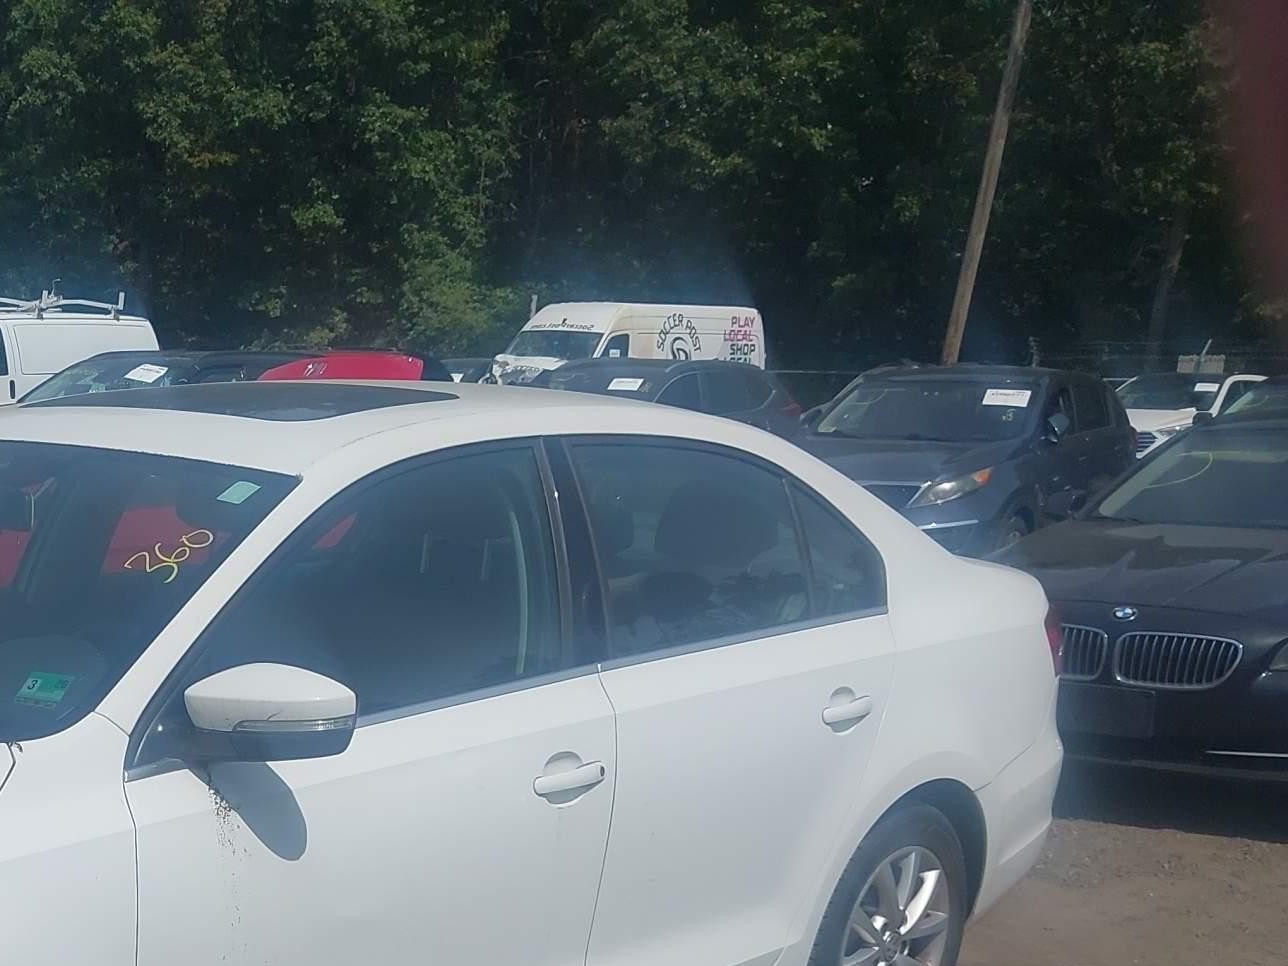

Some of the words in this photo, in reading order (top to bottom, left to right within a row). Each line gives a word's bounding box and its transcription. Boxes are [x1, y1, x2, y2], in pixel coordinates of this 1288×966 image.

[730, 316, 756, 328] PLAY
[657, 313, 684, 352] SOCCER
[685, 319, 702, 352] POST
[723, 329, 754, 342] LOCAL
[729, 343, 756, 356] SHOP
[123, 529, 214, 584] 360
[27, 679, 38, 690] 3
